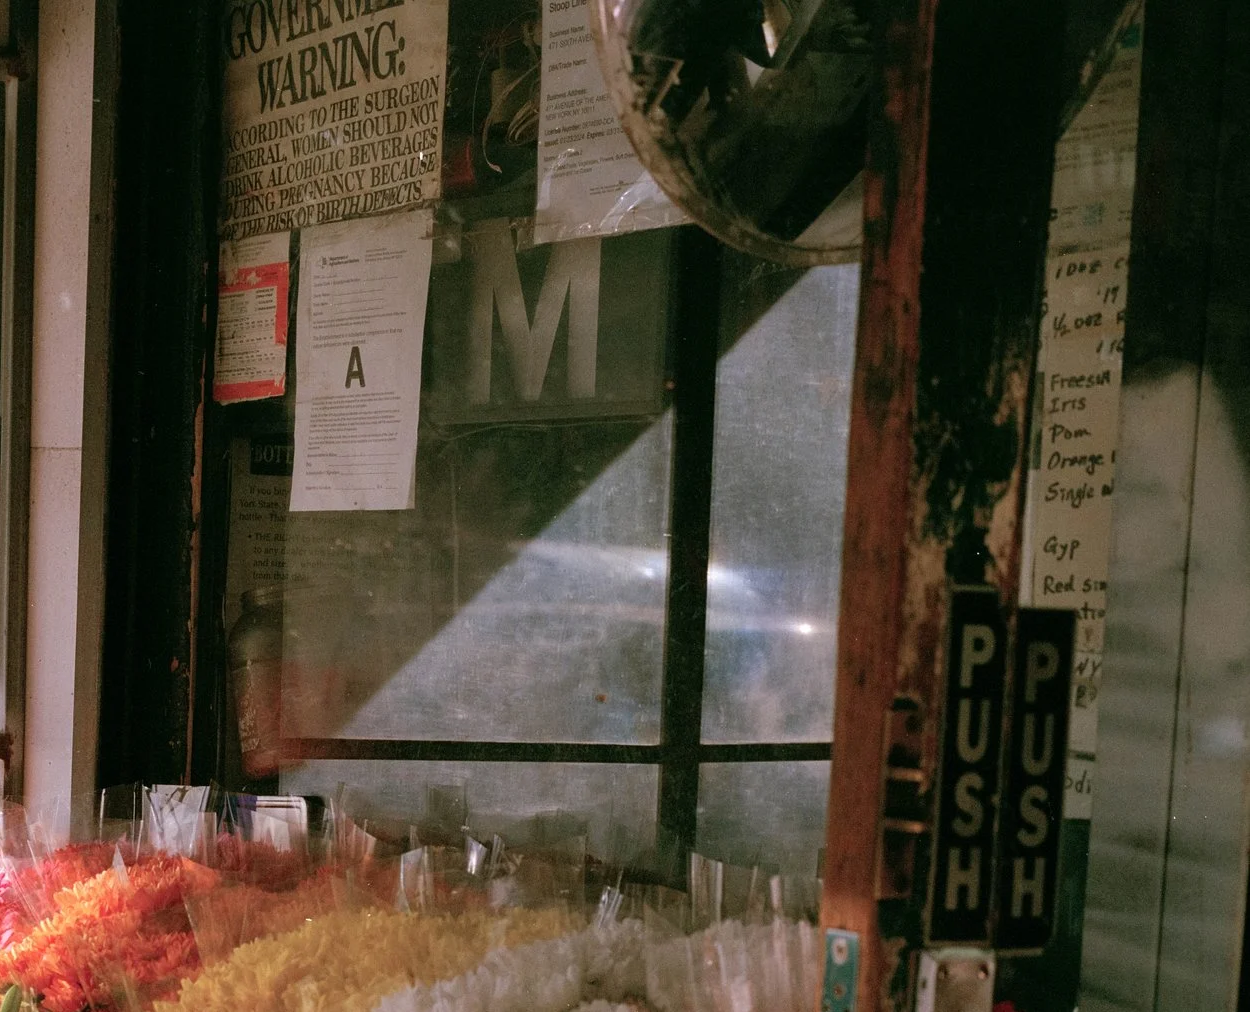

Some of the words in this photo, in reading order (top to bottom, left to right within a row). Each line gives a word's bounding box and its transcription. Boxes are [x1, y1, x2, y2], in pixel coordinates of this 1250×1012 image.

[257, 19, 406, 114] WARNING:
[309, 107, 328, 130] TO
[330, 96, 360, 123] THE
[364, 75, 440, 115] SURGEON
[226, 143, 288, 177] GENERAL,
[291, 126, 340, 159] WOMEN
[342, 111, 407, 144] SHOULD
[409, 100, 439, 129] NOT
[226, 170, 264, 200] DRINK
[267, 149, 346, 188] ALCOHOLIC
[348, 126, 439, 168] BEVERAGES
[226, 191, 276, 221] DURING
[279, 168, 366, 209] PREGNANCY
[370, 151, 437, 189] BECAUSE
[238, 217, 265, 241] THE
[266, 209, 296, 232] RISK
[297, 203, 316, 227] OF
[317, 195, 362, 224] BIRTH
[468, 217, 602, 405] M
[345, 346, 366, 389] A
[944, 624, 996, 911] PUSH
[1010, 641, 1060, 918] PUSH
